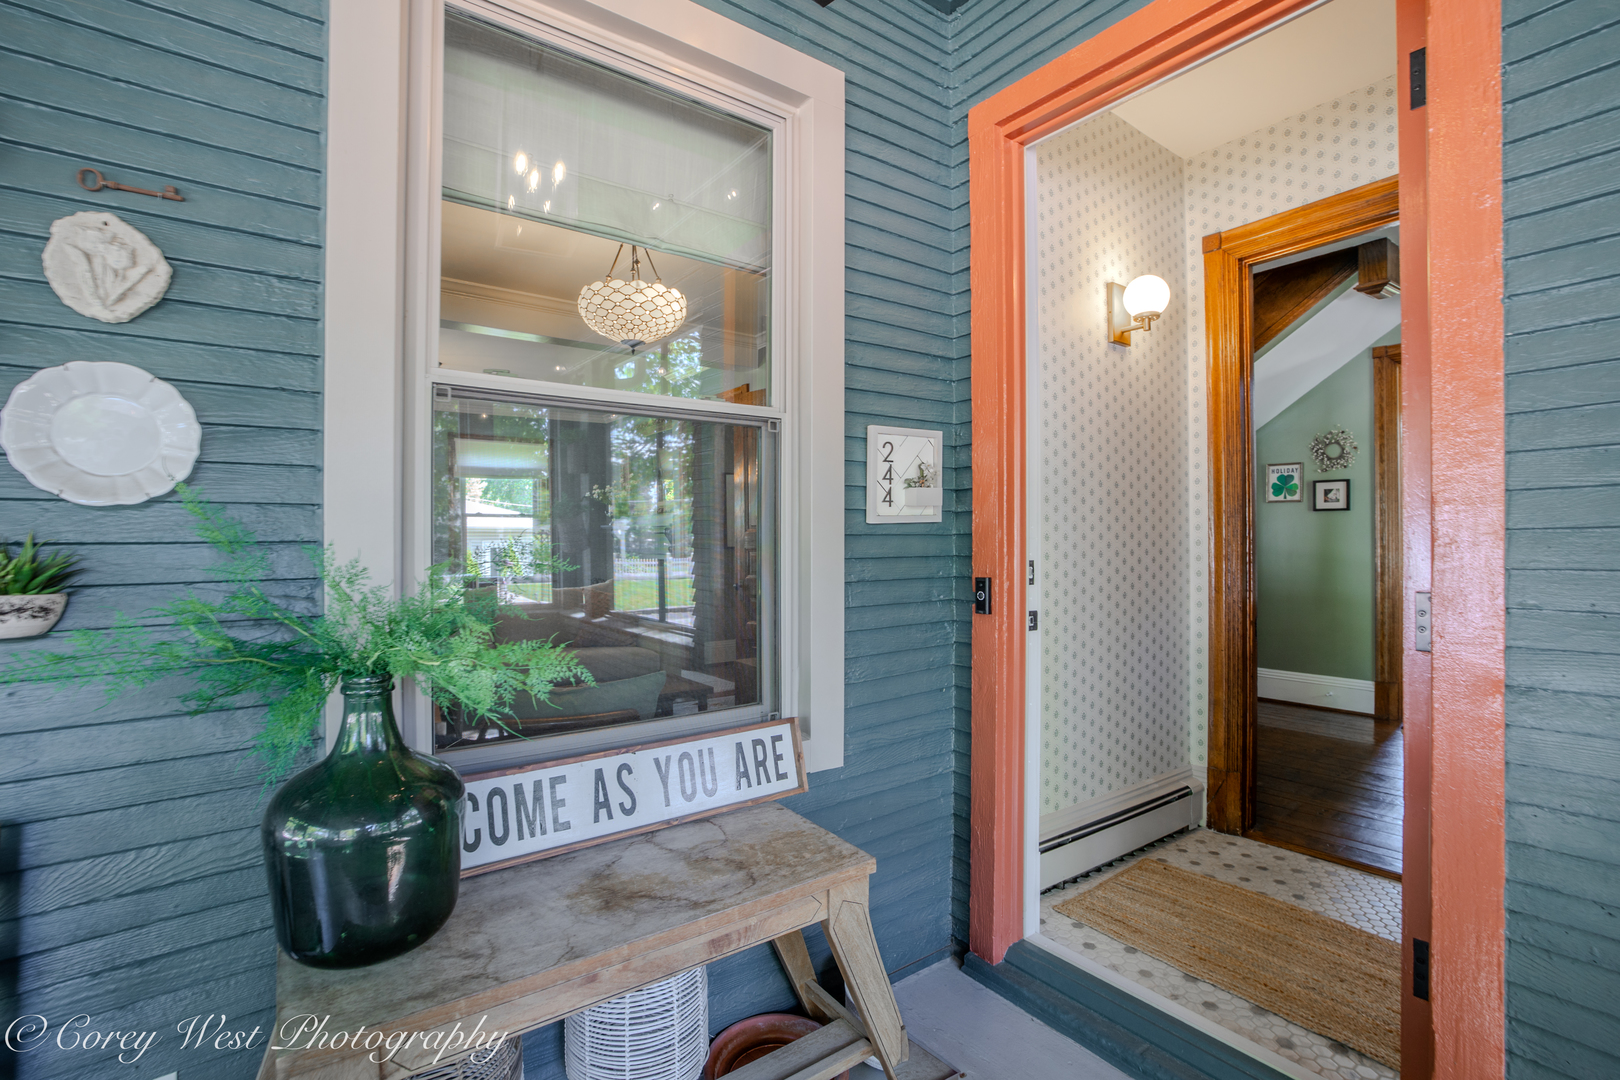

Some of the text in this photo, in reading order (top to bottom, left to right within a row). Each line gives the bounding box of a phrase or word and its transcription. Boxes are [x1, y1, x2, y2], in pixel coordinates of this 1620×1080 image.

[881, 441, 894, 507] 244
[463, 733, 789, 853] COME AS YOU ARE
